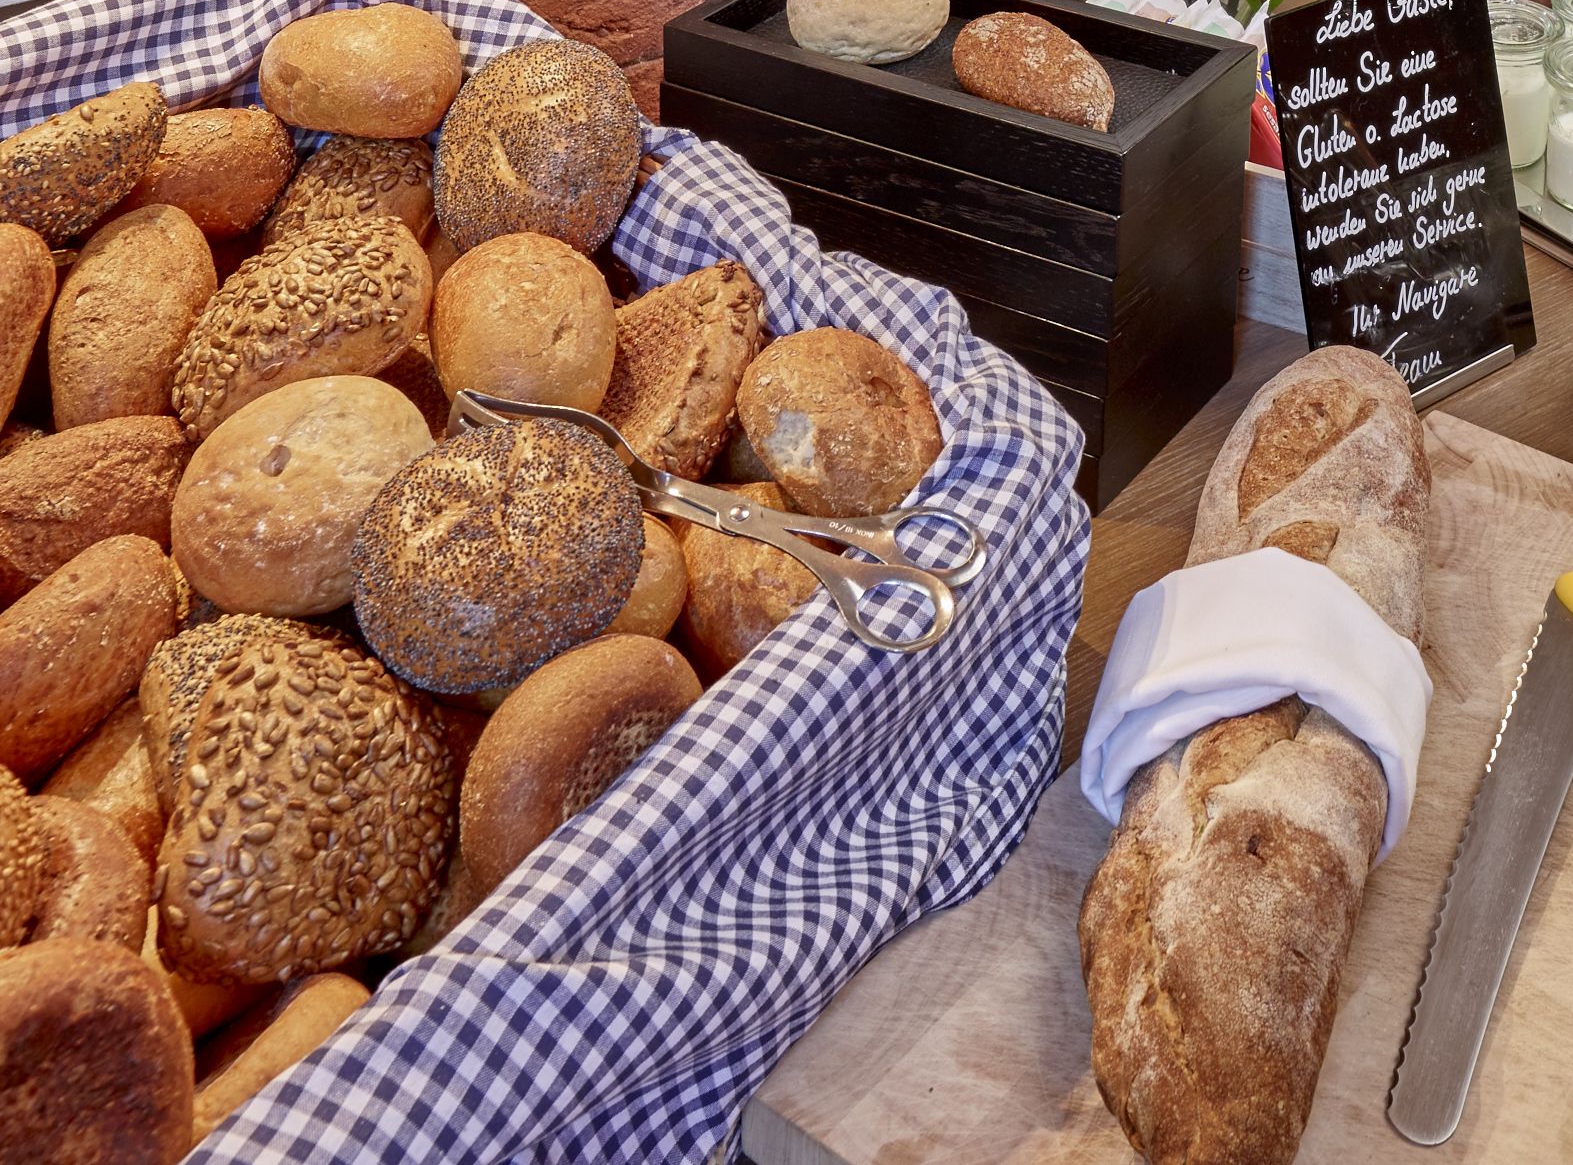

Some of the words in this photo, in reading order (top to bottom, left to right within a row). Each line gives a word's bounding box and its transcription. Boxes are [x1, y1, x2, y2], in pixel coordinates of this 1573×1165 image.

[1288, 67, 1349, 110] sollten
[1357, 51, 1393, 93] Sie
[1401, 50, 1437, 78] eine
[1297, 114, 1356, 169] Gluten
[1390, 83, 1458, 137] Lactose
[1302, 166, 1390, 213] intoleranz
[1307, 209, 1367, 251] wenden
[1375, 193, 1403, 224] Sie
[1408, 175, 1437, 213] sich
[1443, 166, 1486, 216] gerne
[1352, 303, 1381, 338] Ihr
[1391, 266, 1479, 321] Navigare
